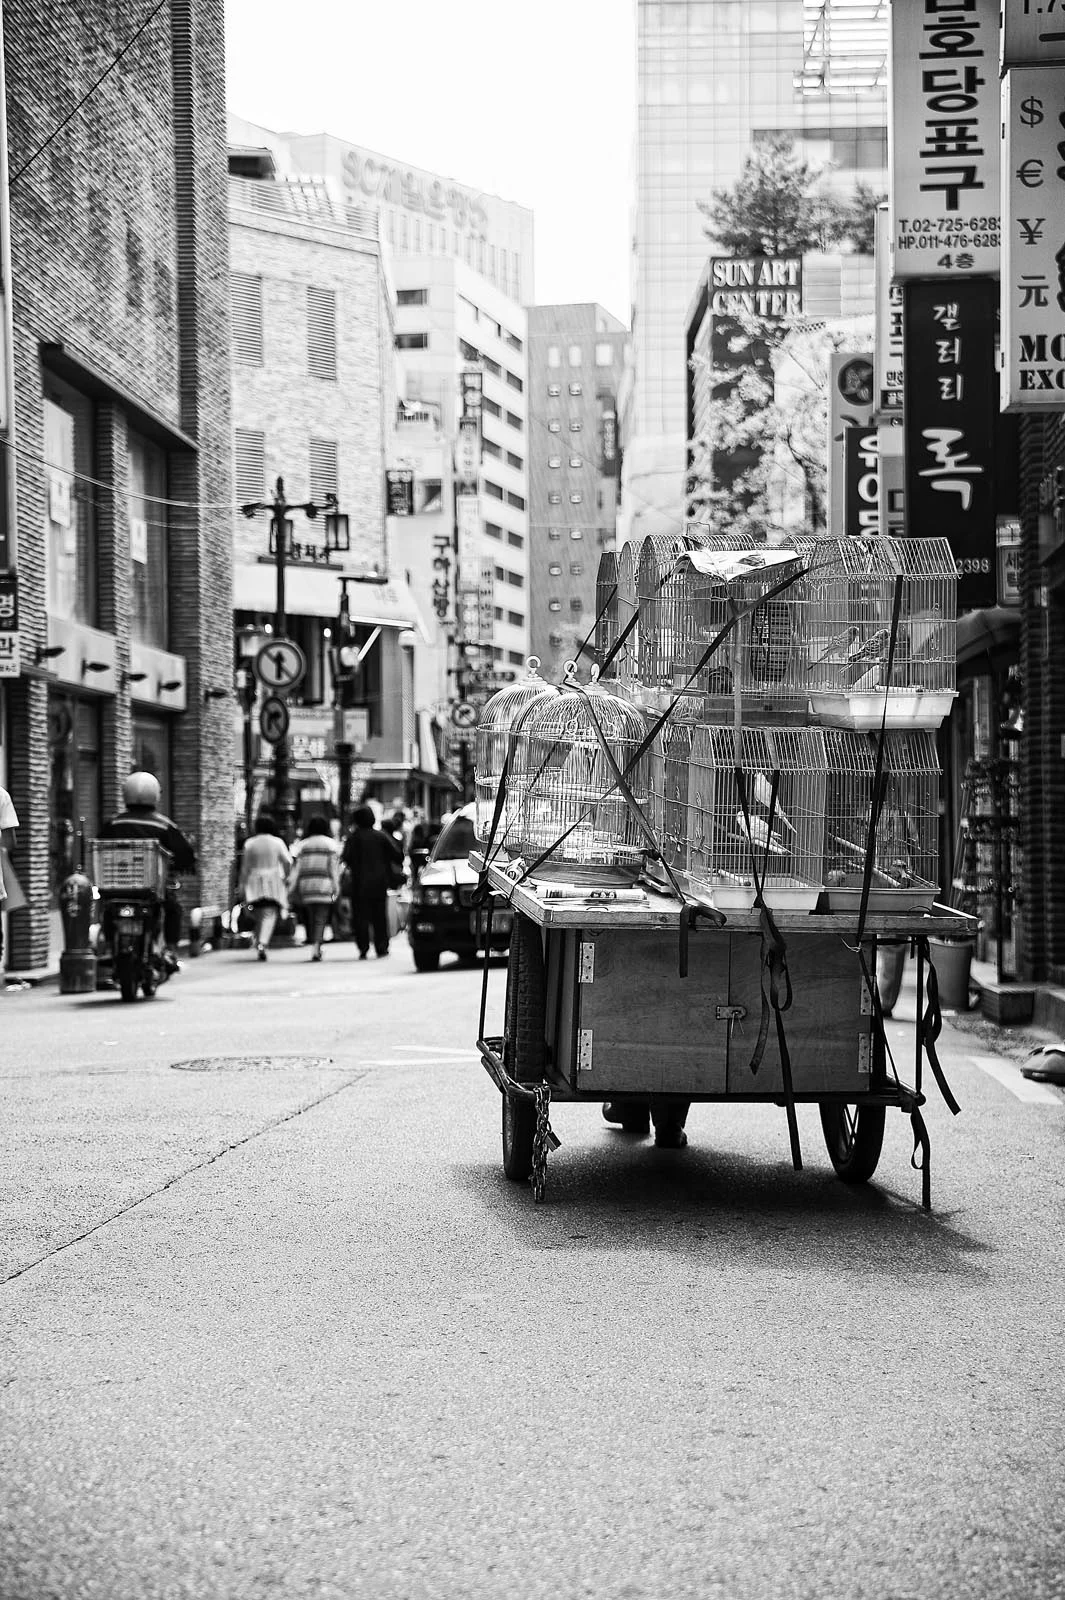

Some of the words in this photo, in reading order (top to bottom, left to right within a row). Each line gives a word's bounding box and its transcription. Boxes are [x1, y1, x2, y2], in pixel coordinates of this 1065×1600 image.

[898, 233, 1000, 250] HP.011-476-628
[713, 260, 755, 287] SUN
[758, 260, 801, 286] ART
[712, 289, 801, 317] CENTER
[1017, 275, 1049, 308] 元
[932, 303, 963, 401] 갤러리
